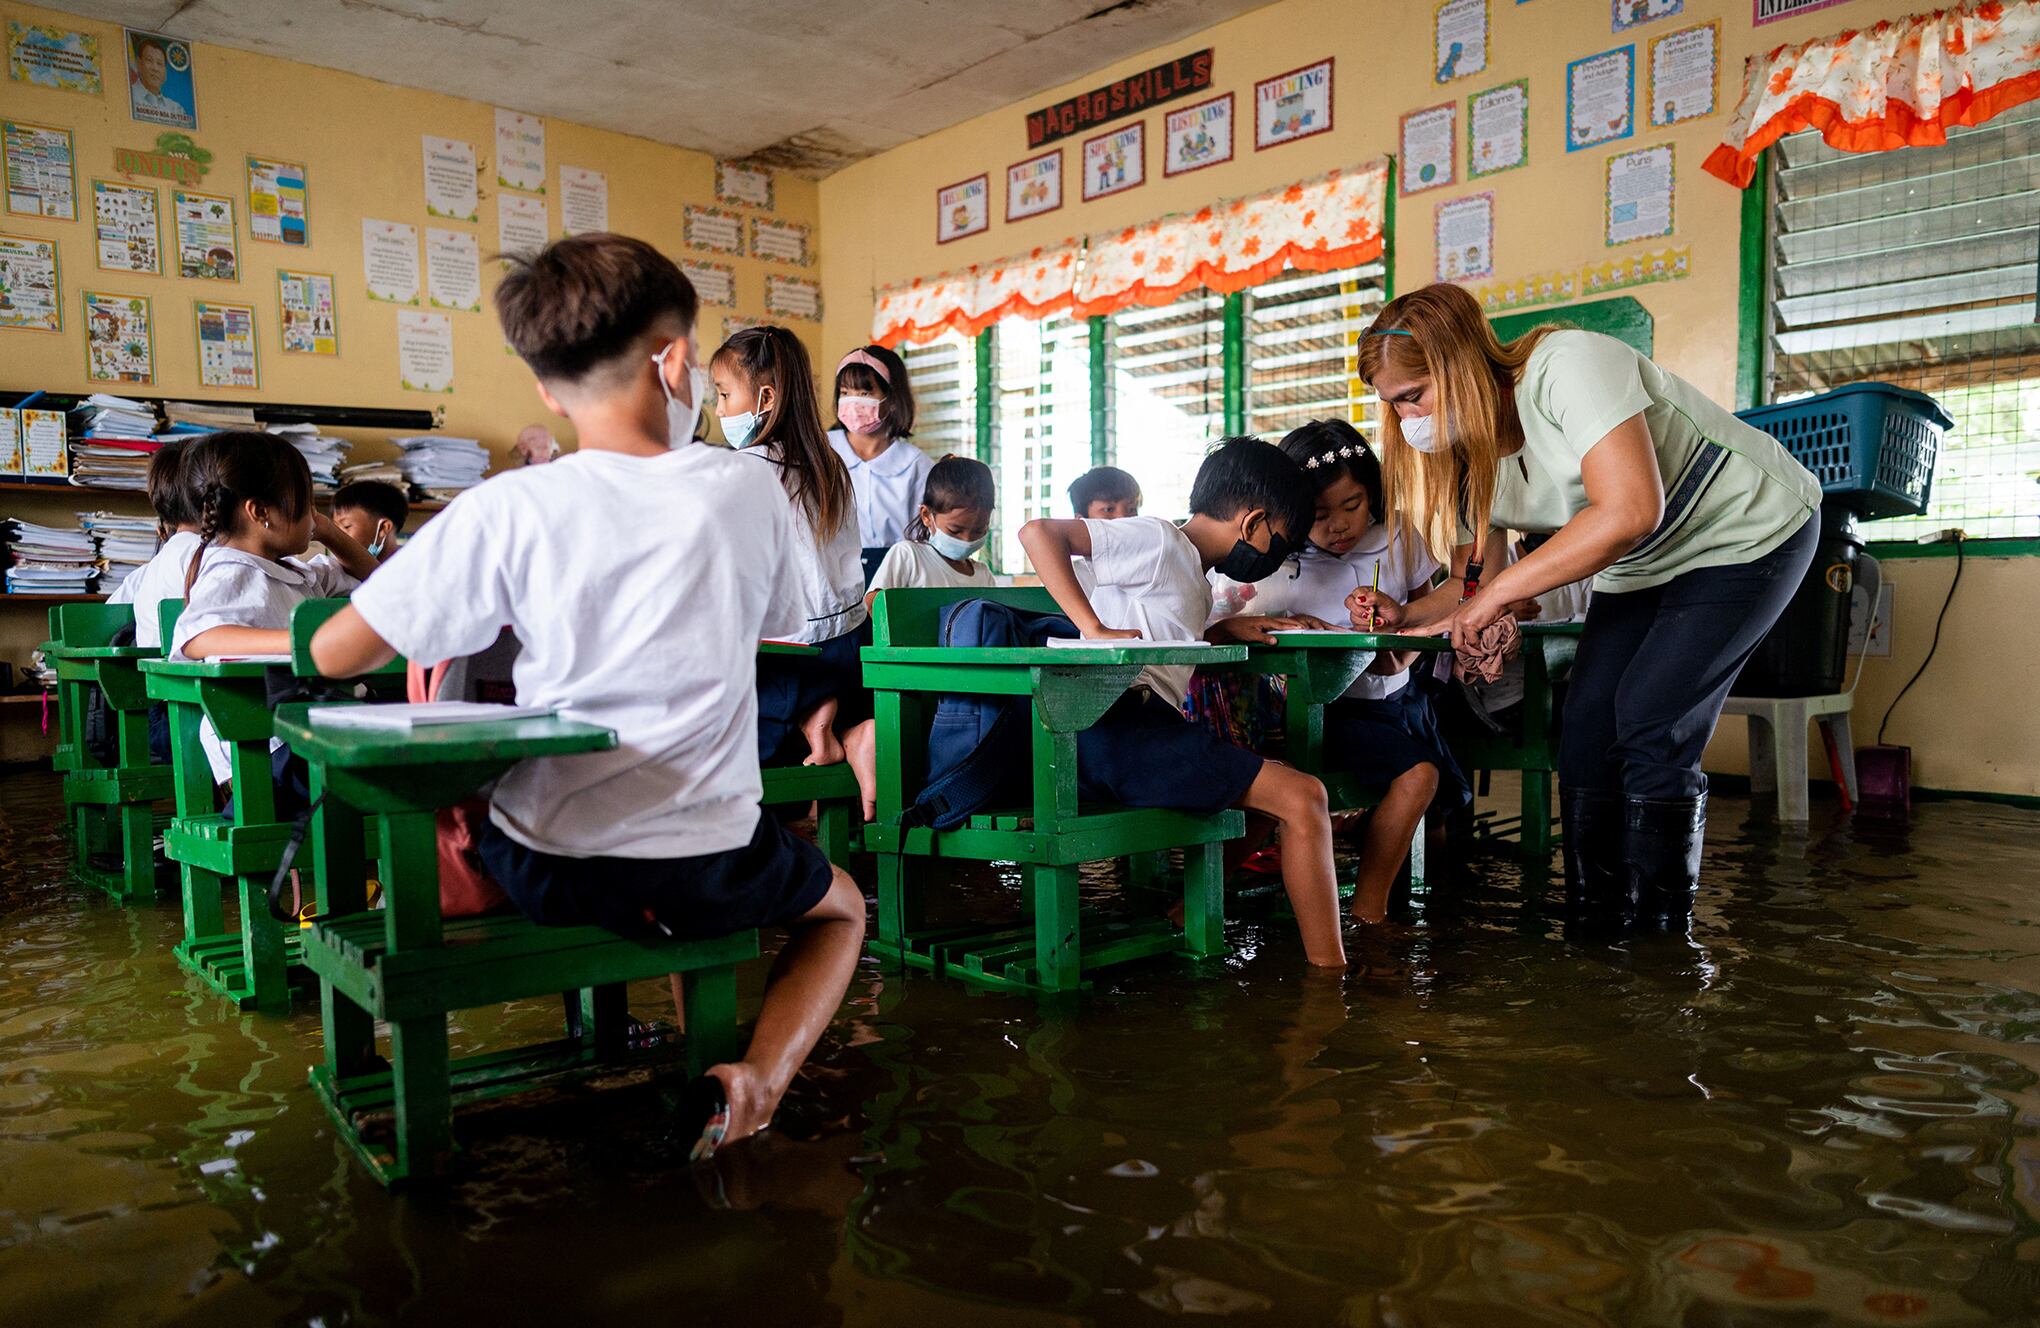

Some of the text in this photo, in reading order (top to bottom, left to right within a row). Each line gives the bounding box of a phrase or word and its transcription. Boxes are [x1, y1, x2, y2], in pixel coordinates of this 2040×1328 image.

[1263, 69, 1324, 101] VIEWING
[1480, 94, 1515, 110] Idioms
[1171, 102, 1226, 133] LISTENING
[1089, 130, 1137, 158] SPEAKING
[120, 149, 199, 182] UNITS
[1013, 158, 1055, 182] WRITING
[1626, 156, 1652, 168] Puns
[943, 182, 982, 206] READING
